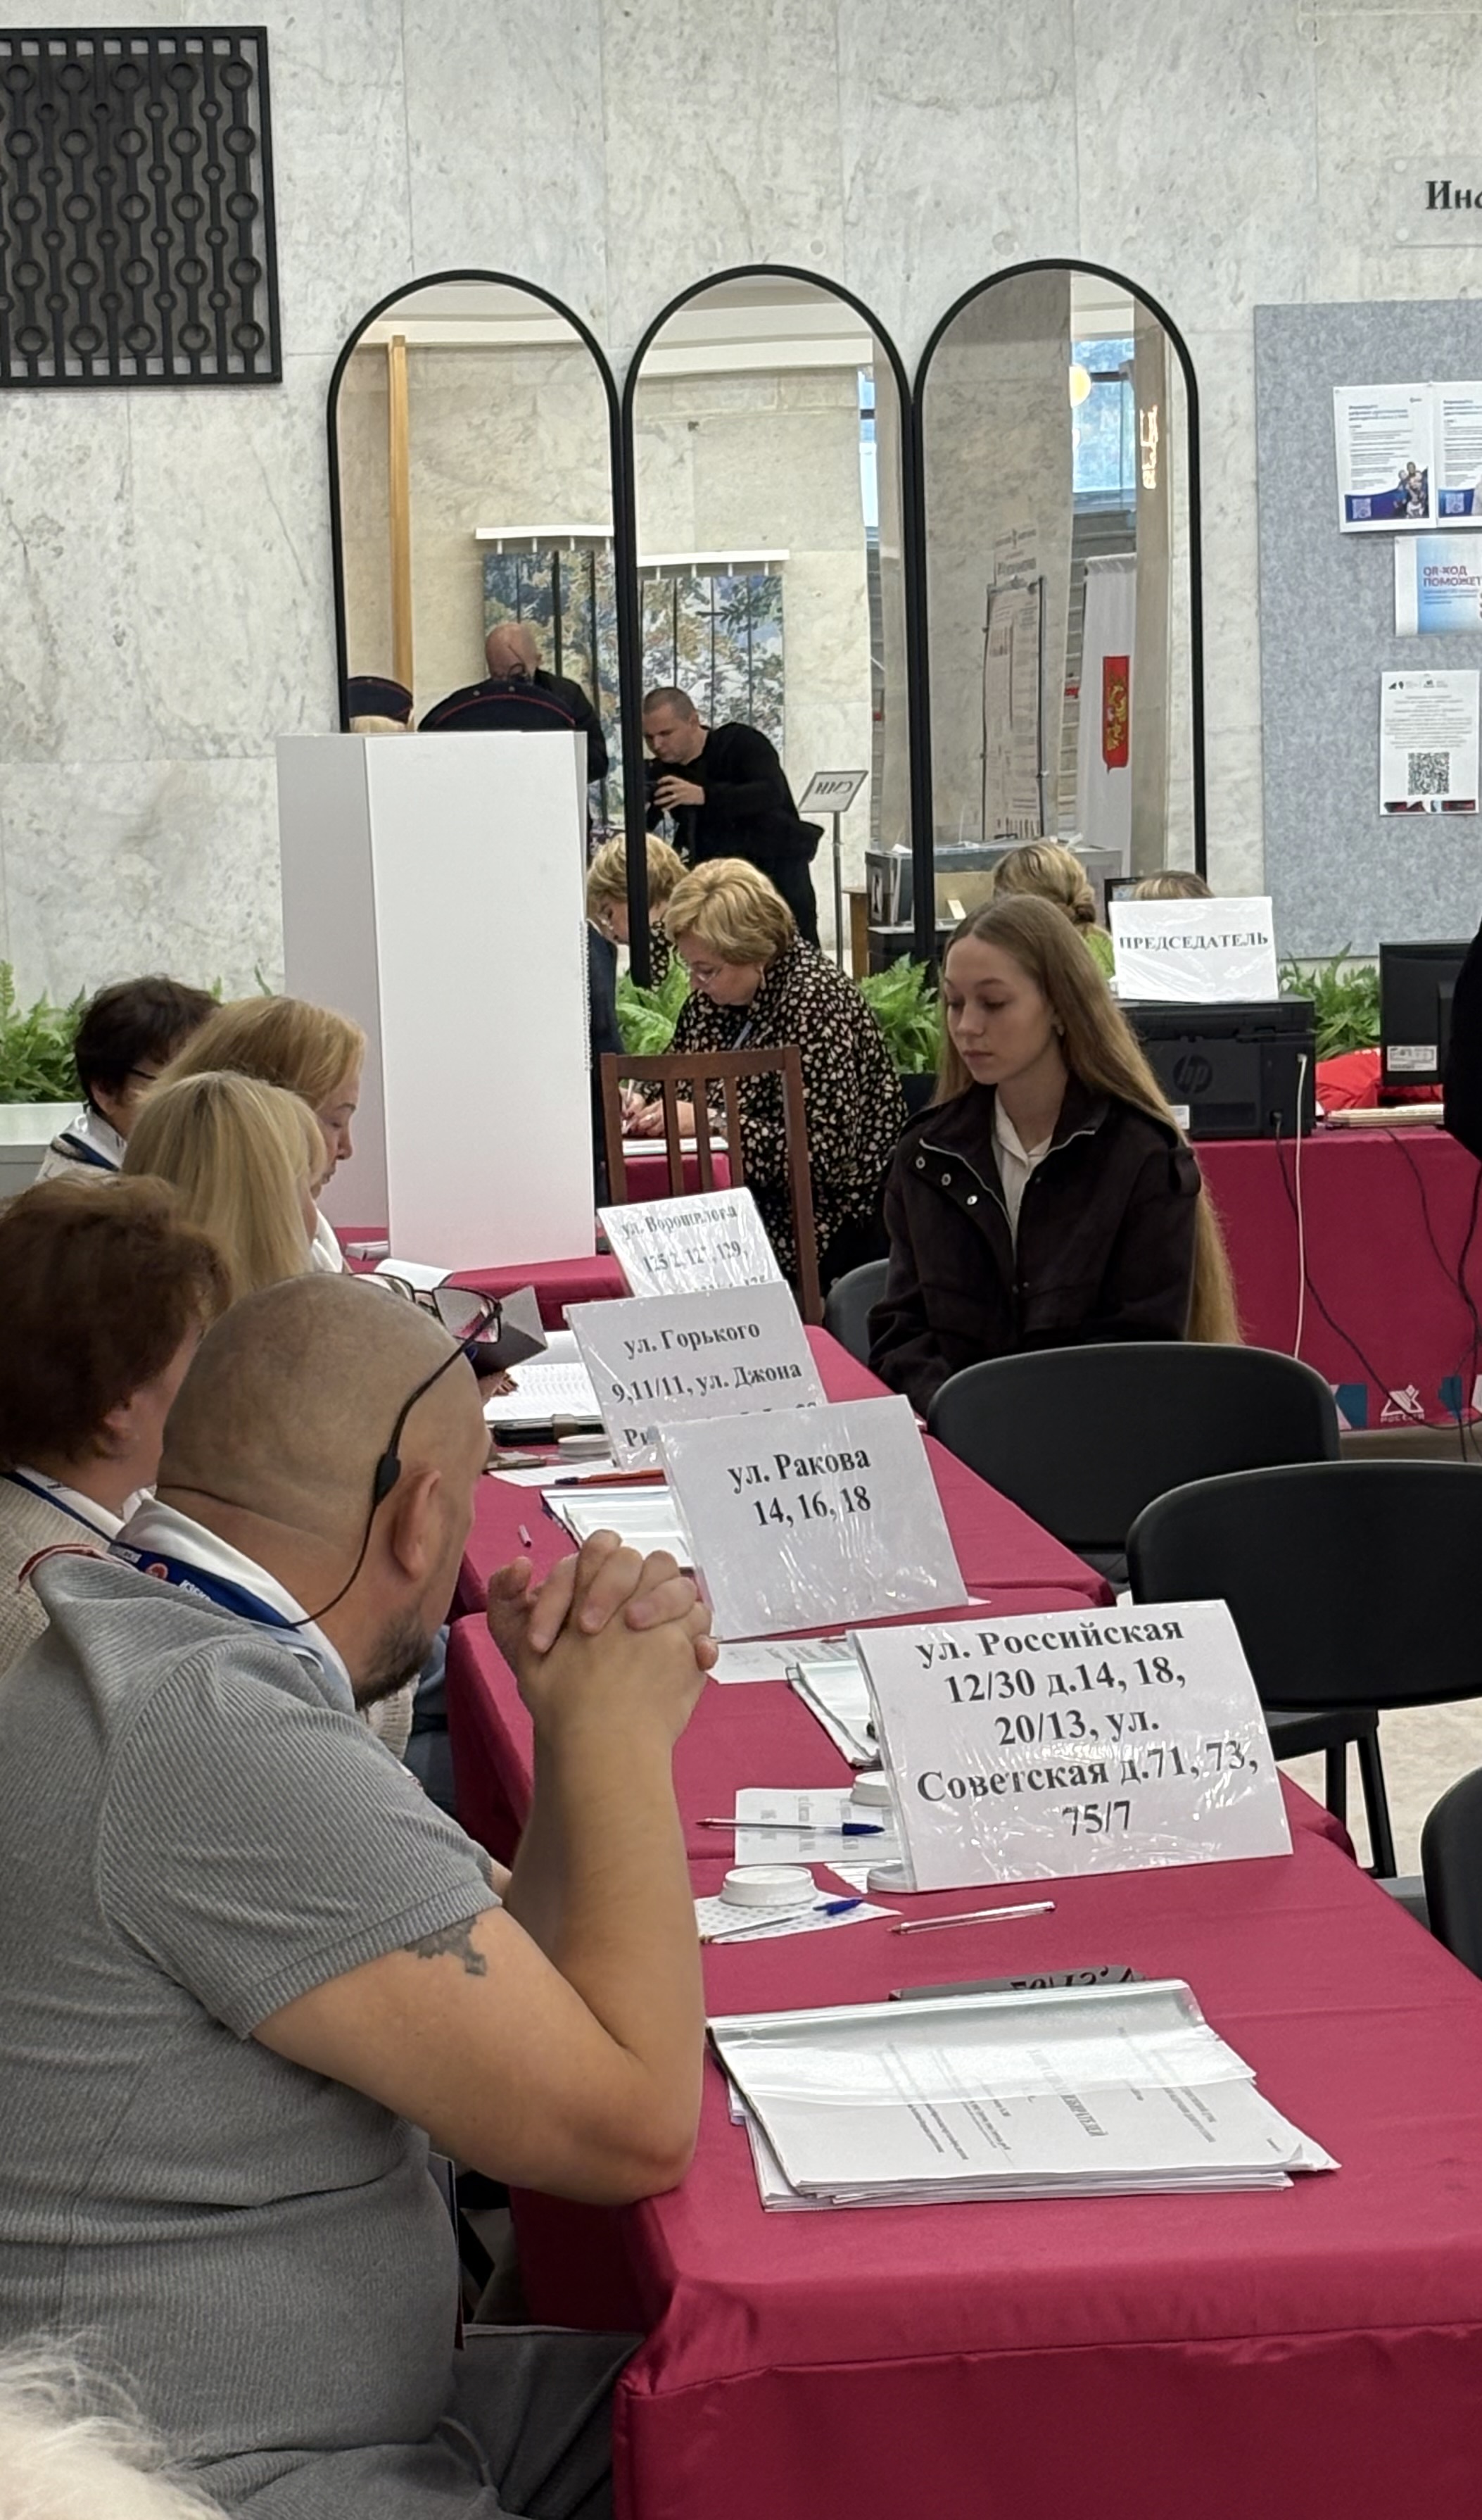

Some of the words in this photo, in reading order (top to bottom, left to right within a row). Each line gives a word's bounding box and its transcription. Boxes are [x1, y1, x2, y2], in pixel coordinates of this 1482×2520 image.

[1120, 932, 1268, 951] ПРЕДСЕДАТЕЛЬ
[1174, 1054, 1211, 1094] hp
[623, 1338, 657, 1360] ул.
[659, 1323, 761, 1352] Горького
[612, 1375, 693, 1405] 9,11/11,
[696, 1374, 730, 1397] ул.
[732, 1363, 802, 1388] Джона
[727, 1465, 771, 1494] ул.
[773, 1449, 872, 1480] Ракова
[753, 1497, 794, 1527] 14,
[797, 1489, 837, 1521] 16,
[840, 1485, 871, 1513] 18
[916, 1642, 970, 1669] ул.
[975, 1621, 1185, 1656] Российская
[944, 1668, 1035, 1703] 12/30
[1046, 1661, 1127, 1698] д.14,
[1133, 1656, 1186, 1688] 18,
[994, 1709, 1099, 1746] 20/13,
[1105, 1711, 1160, 1742] ул.
[917, 1762, 1110, 1801] Советская
[1120, 1746, 1200, 1786] д.71,
[1206, 1740, 1258, 1775] 73,
[1061, 1800, 1130, 1836] 75/7
